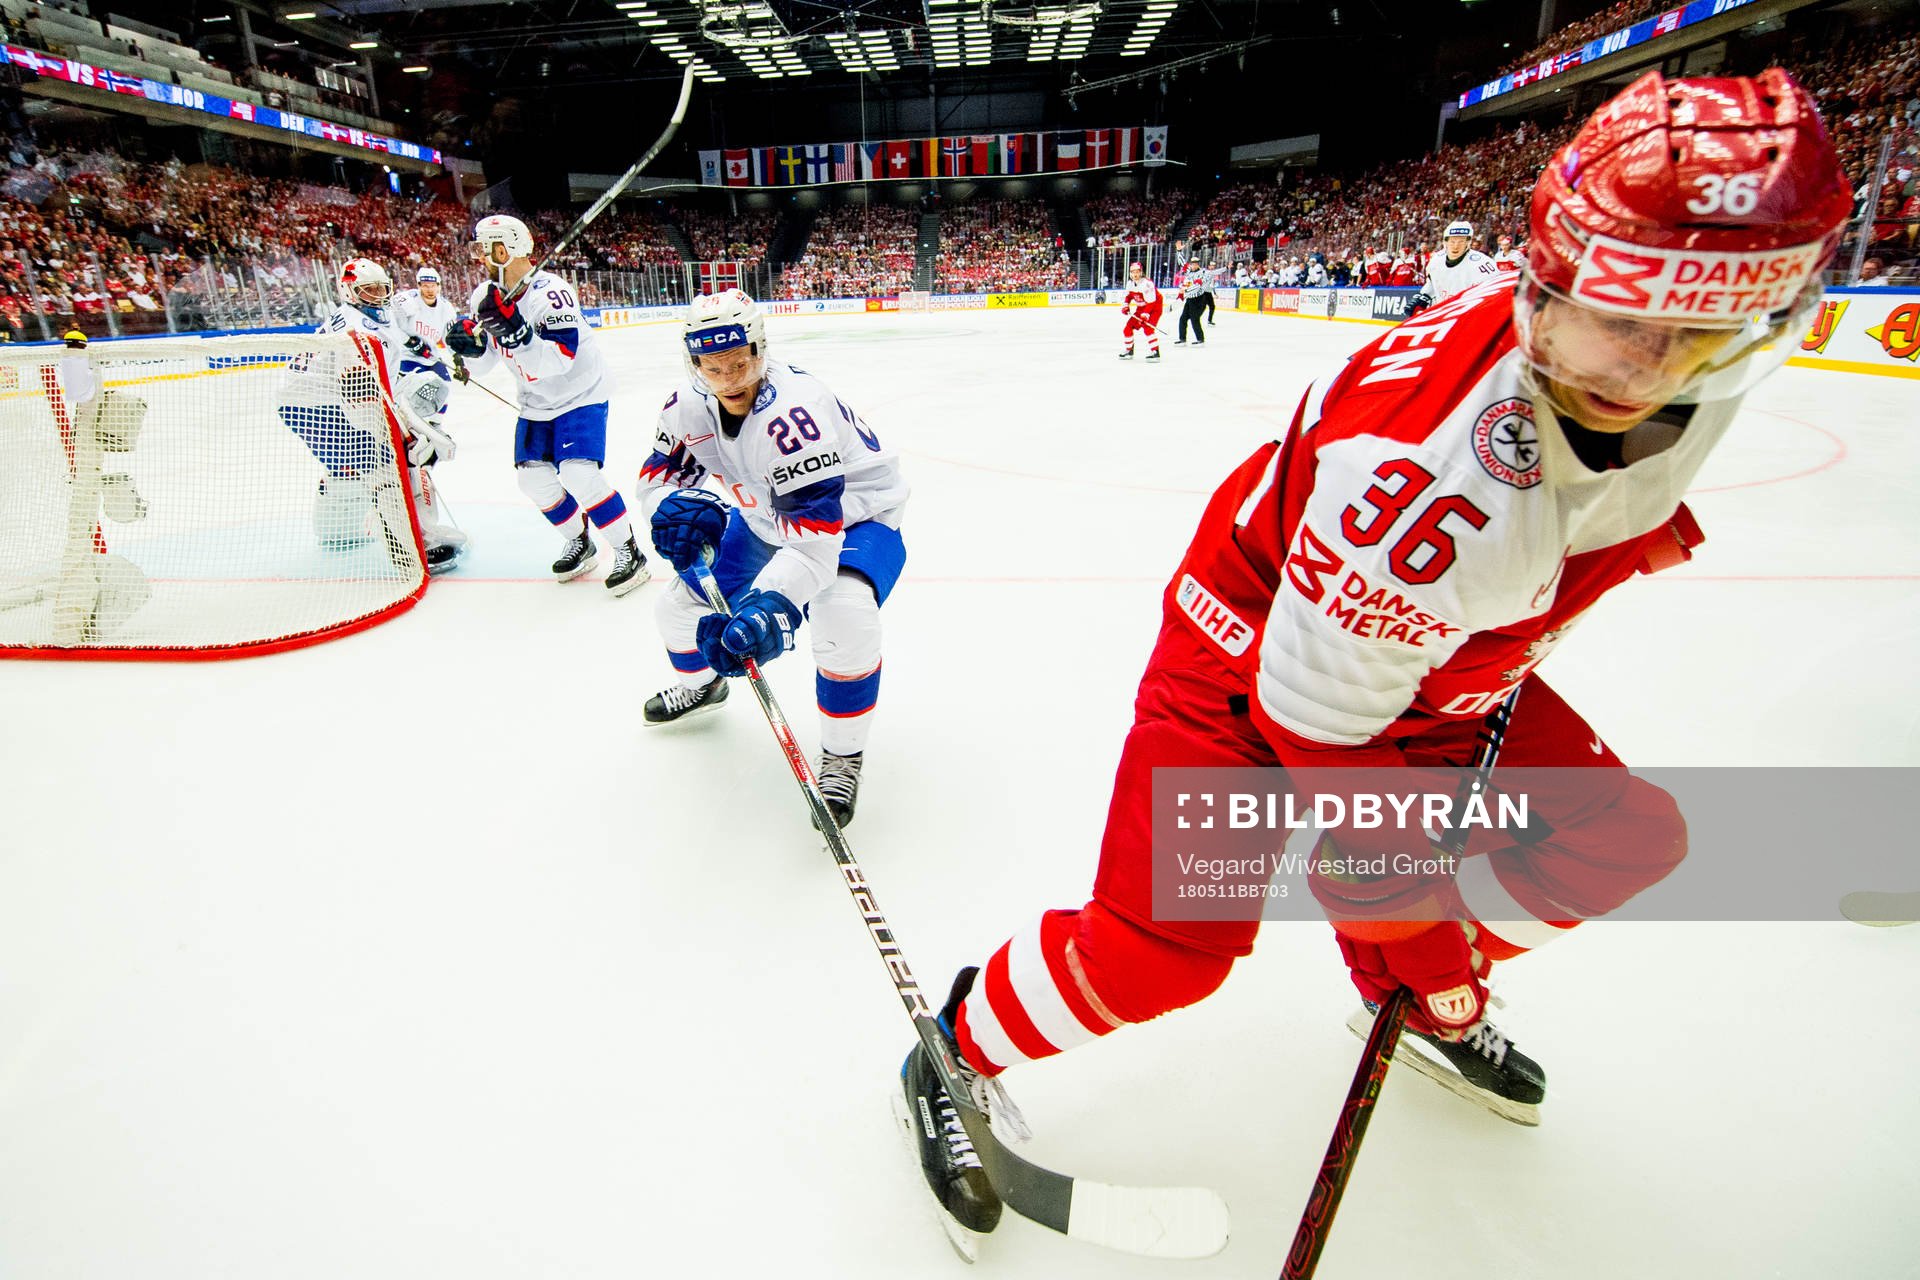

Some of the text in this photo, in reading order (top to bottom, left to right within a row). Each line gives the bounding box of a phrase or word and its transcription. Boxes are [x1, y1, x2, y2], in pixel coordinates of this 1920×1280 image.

[1601, 29, 1631, 55] NOR
[66, 60, 94, 86] VS
[1538, 59, 1554, 80] VS
[171, 86, 204, 110] NOR
[1481, 80, 1501, 100] DEN
[280, 111, 305, 133] DEN
[349, 129, 364, 147] VS
[1686, 173, 1759, 216] 36
[1479, 262, 1495, 275] 40
[1672, 252, 1812, 286] DANSK
[547, 290, 574, 310] 90
[775, 304, 800, 314] IIHF
[1308, 295, 1327, 304] TISSOT
[1348, 295, 1372, 306] TISSOT
[1374, 296, 1408, 315] NIVEA
[1660, 285, 1787, 313] METAL
[768, 406, 821, 456] 28
[772, 451, 842, 485] ŠKODA
[1477, 444, 1516, 481] UNION
[1340, 458, 1490, 585] 36
[1341, 570, 1463, 639] DANSK
[1190, 593, 1246, 643] IIHF
[1325, 596, 1429, 648] METAL
